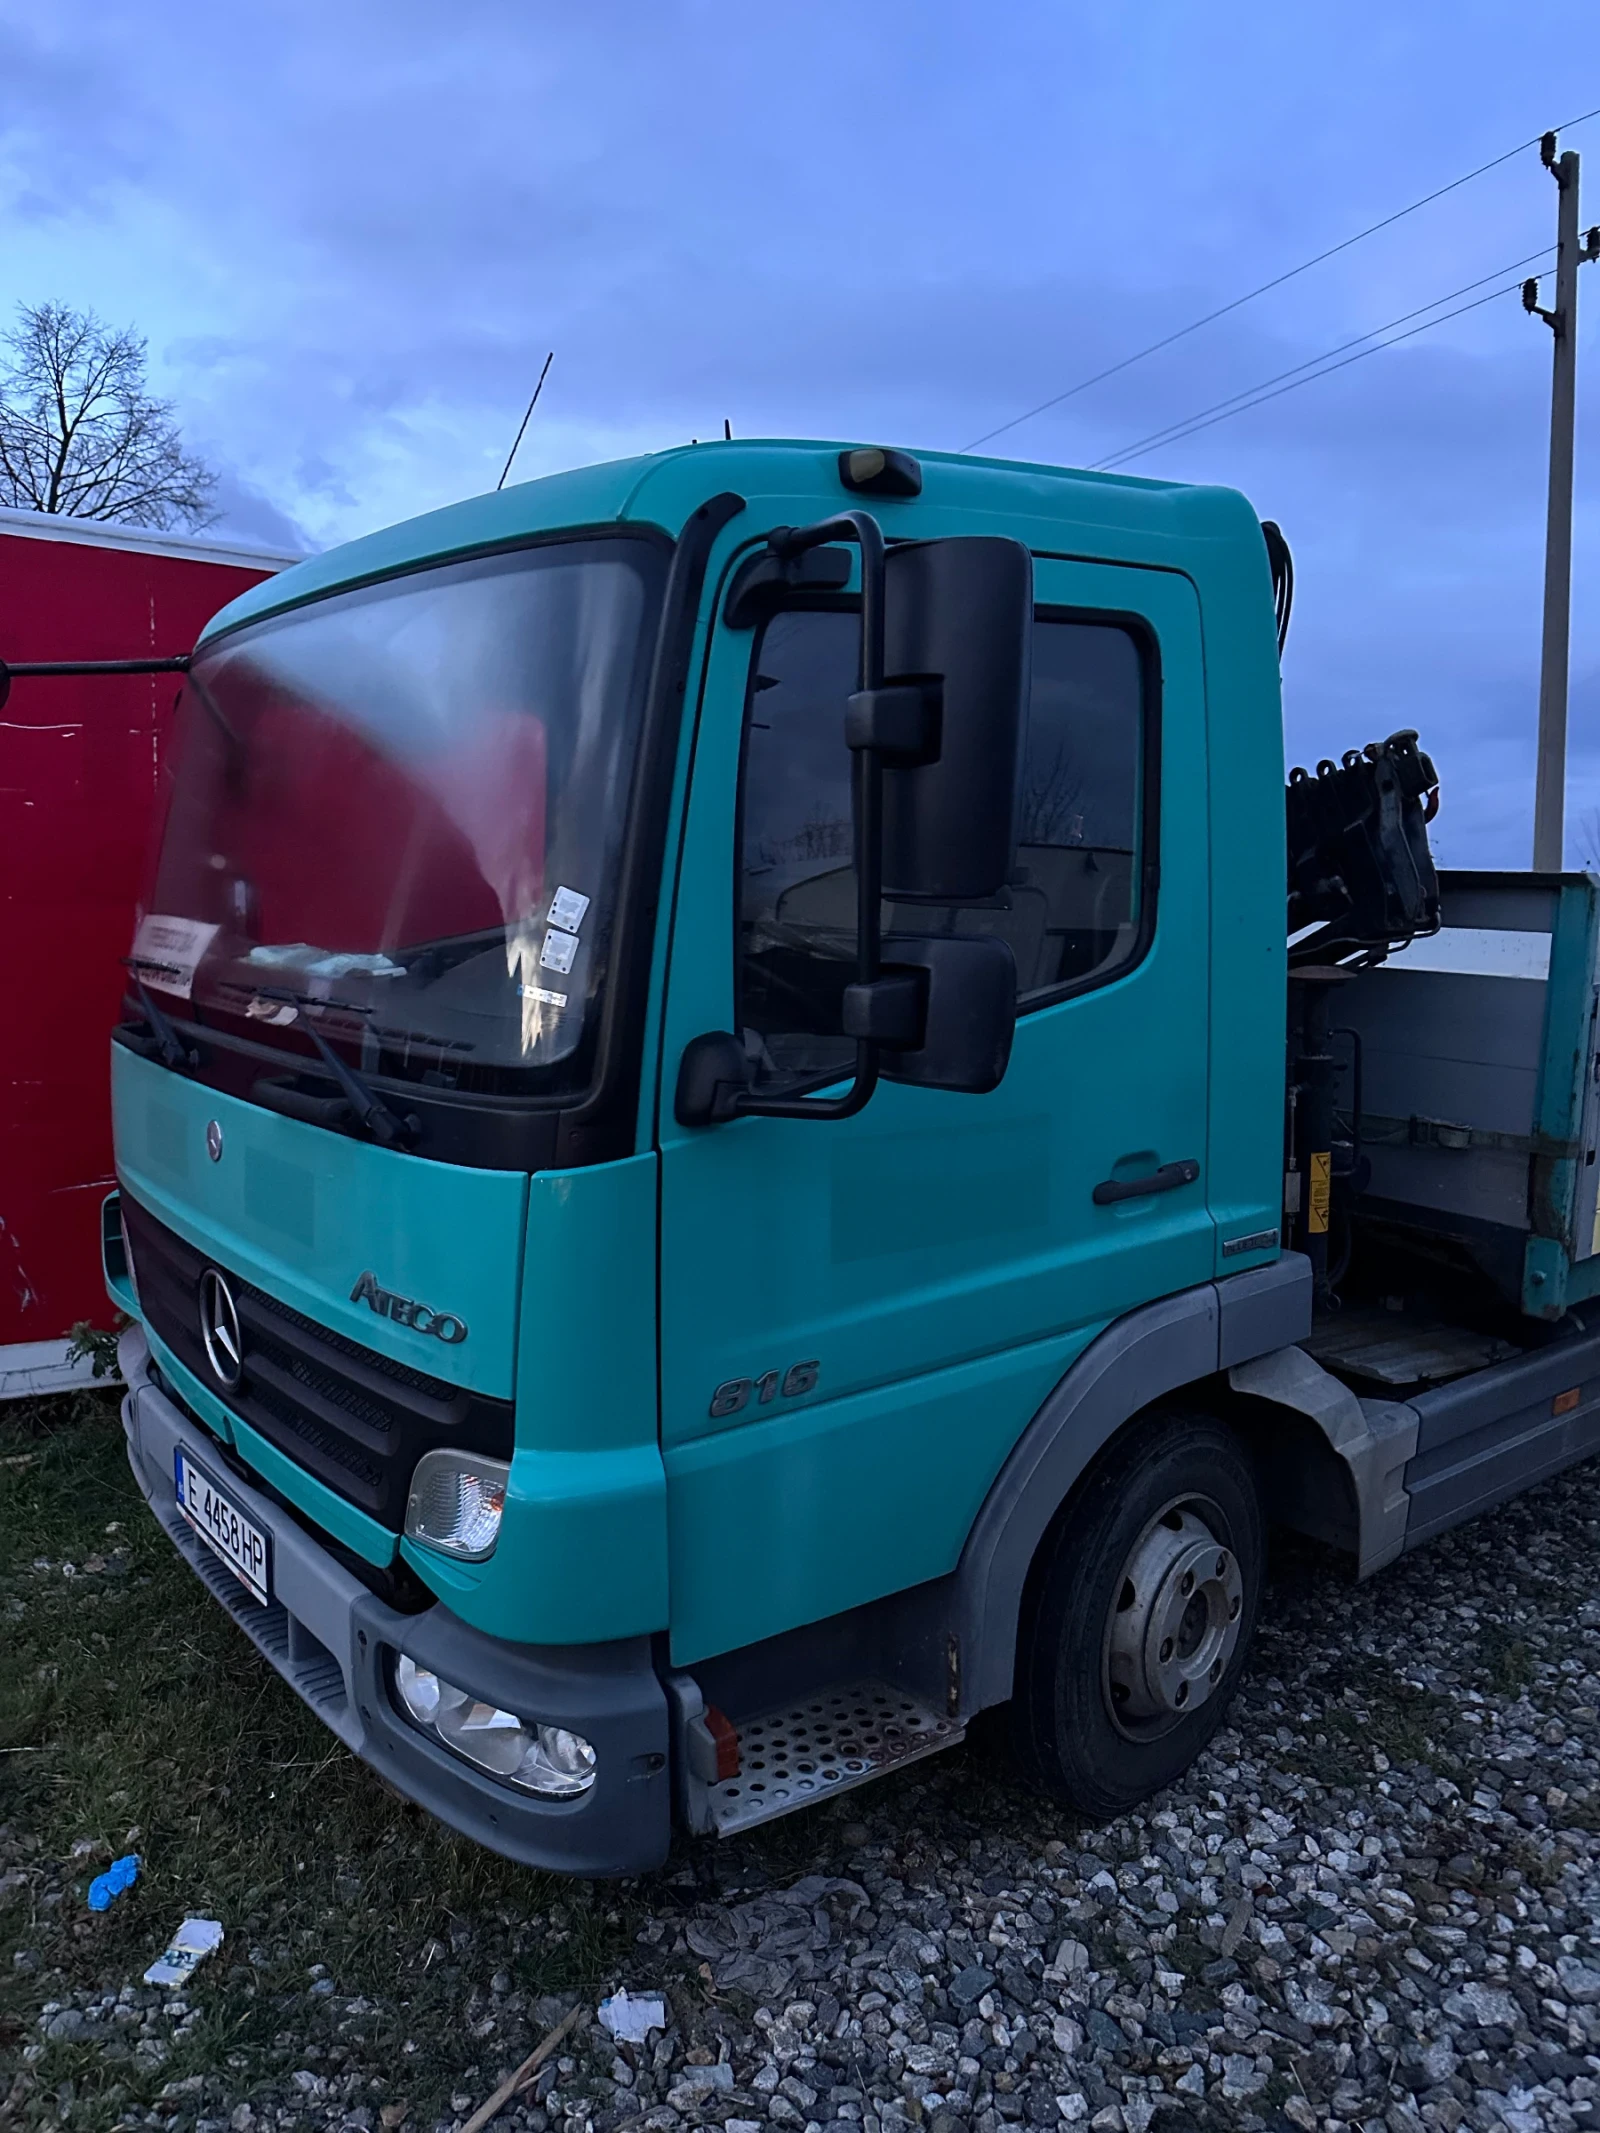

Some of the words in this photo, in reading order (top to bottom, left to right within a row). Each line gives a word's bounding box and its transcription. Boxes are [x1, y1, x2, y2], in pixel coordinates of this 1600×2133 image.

[350, 1270, 468, 1344] ATEGO
[709, 1360, 820, 1418] 816
[188, 1468, 199, 1513] E
[204, 1488, 240, 1556] 4458
[242, 1522, 264, 1576] HP
